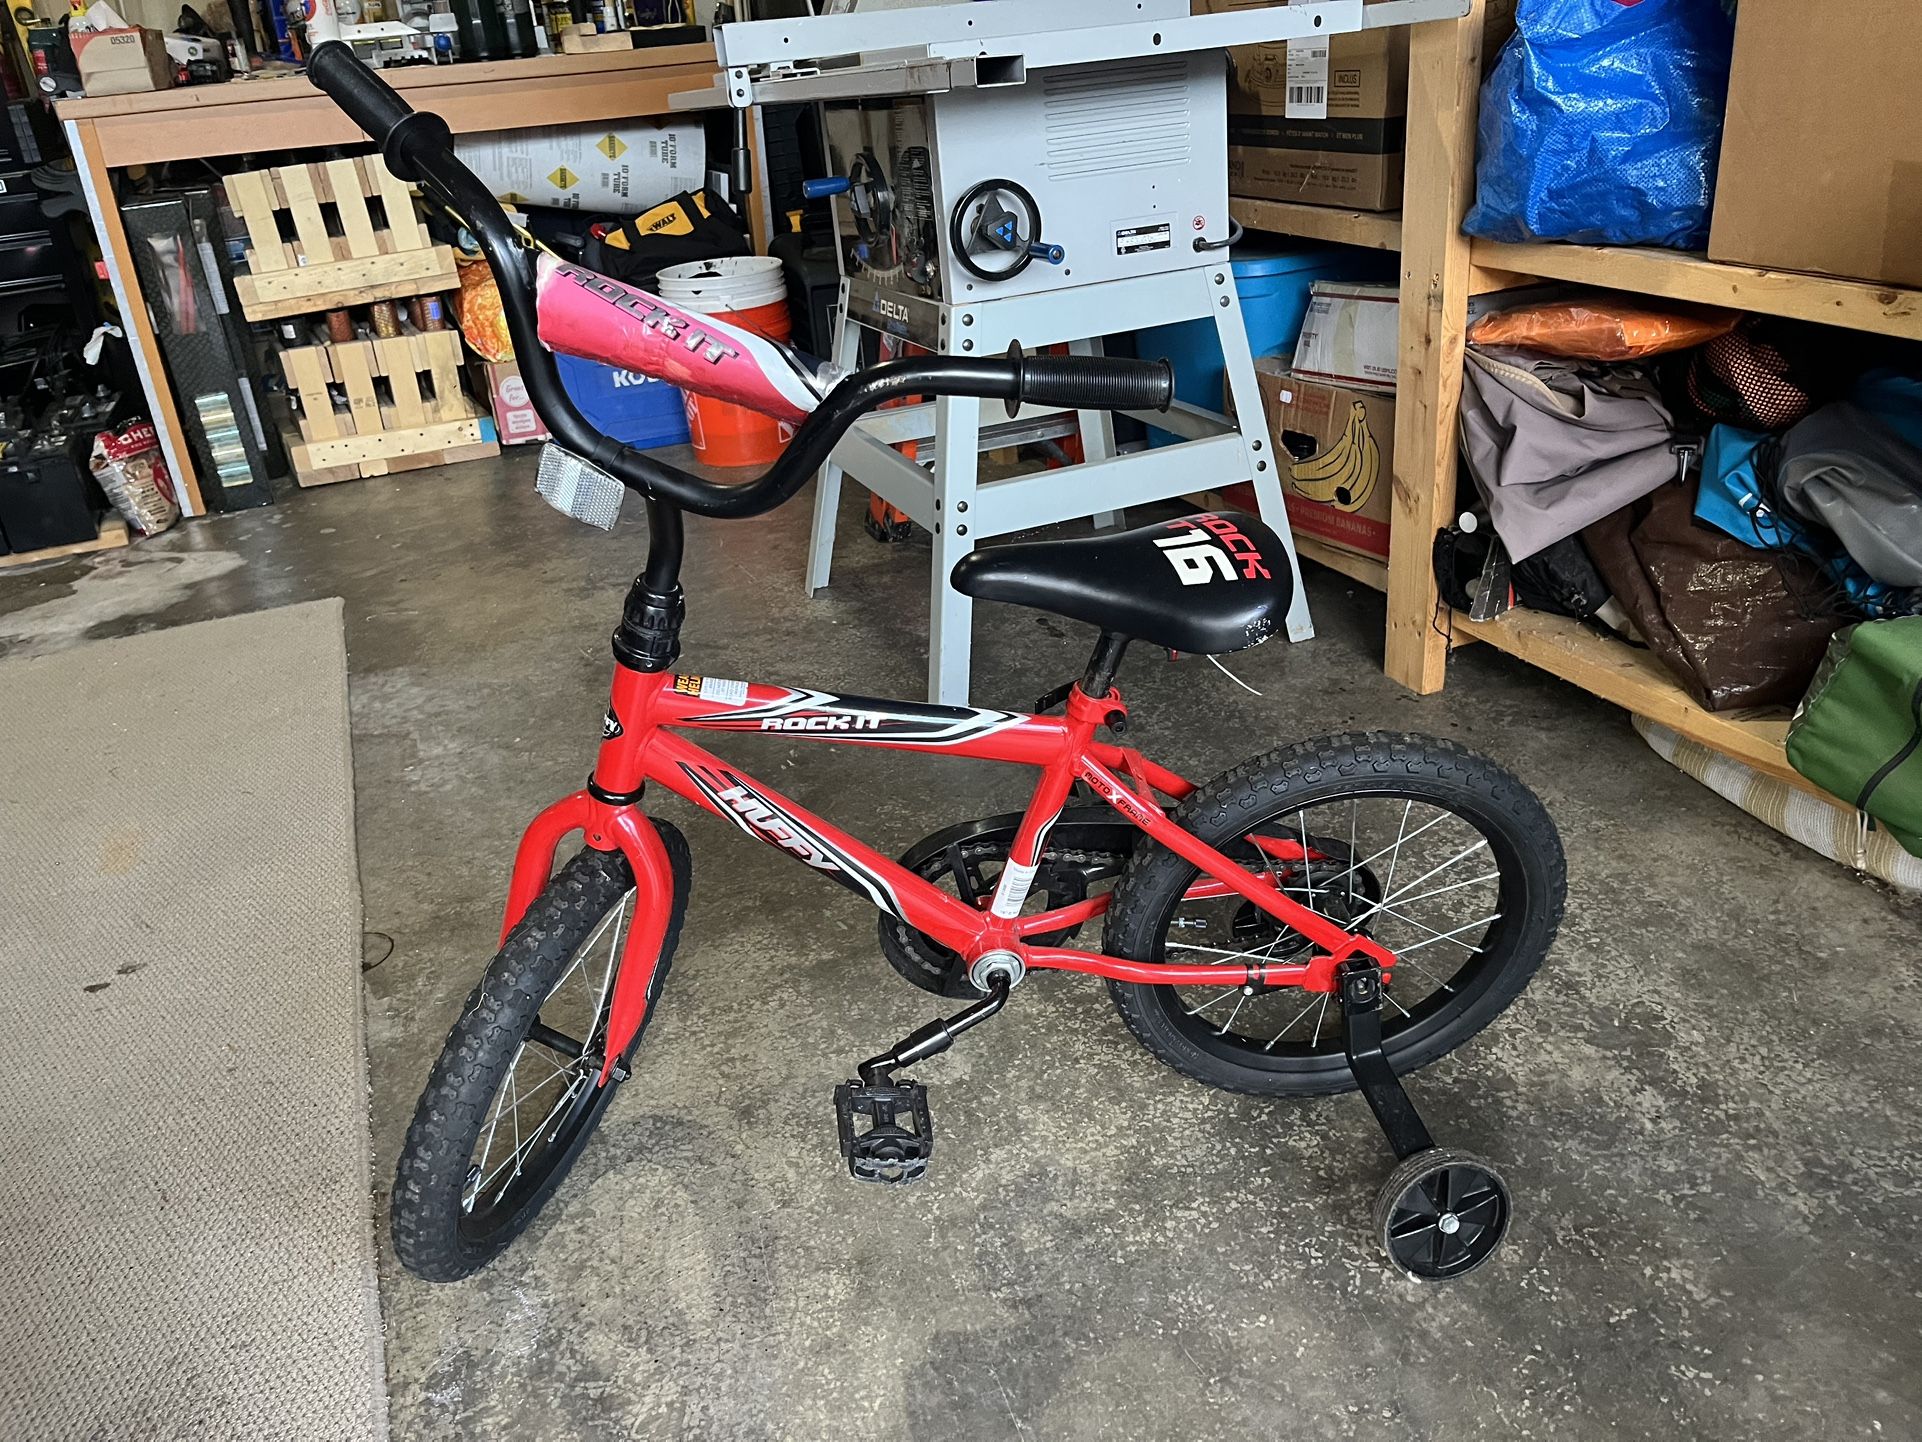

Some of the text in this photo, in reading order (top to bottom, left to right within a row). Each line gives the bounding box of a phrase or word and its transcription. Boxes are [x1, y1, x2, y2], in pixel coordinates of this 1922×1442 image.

[111, 34, 136, 45] 05320
[555, 263, 740, 365] ROCK IT
[880, 299, 909, 323] DELTA
[612, 368, 661, 388] KO
[1196, 513, 1272, 579] ROCK
[1336, 517, 1372, 537] BANANAS
[1152, 528, 1239, 586] 16
[760, 714, 885, 731] ROCK IT
[1084, 771, 1151, 826] MOTO X FRAME
[717, 785, 841, 871] HUFFY
